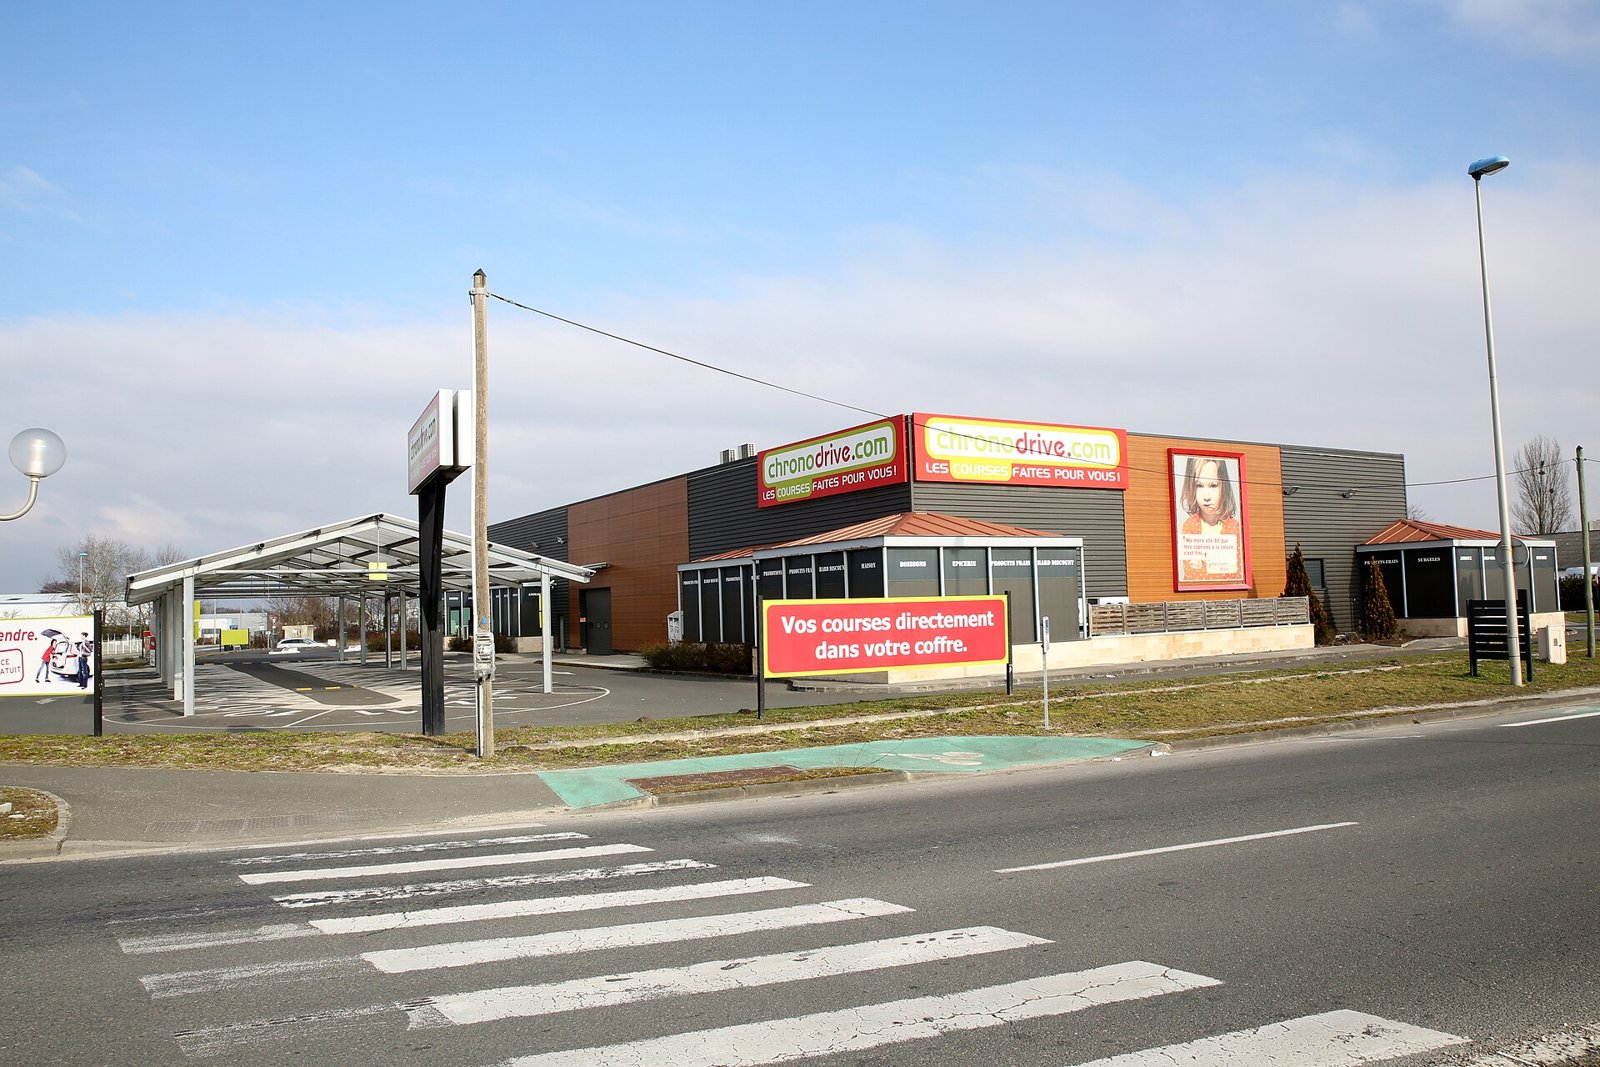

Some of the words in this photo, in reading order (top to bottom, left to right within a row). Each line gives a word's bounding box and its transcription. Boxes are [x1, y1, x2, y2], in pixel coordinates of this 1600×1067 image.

[936, 427, 1111, 460] chronodrive.com
[768, 436, 888, 479] chronodrive.com
[925, 462, 949, 474] LES
[953, 463, 1010, 477] COURSES
[1012, 467, 1051, 479] FAITES
[1054, 468, 1085, 480] POUR
[762, 490, 776, 501] LES
[776, 483, 811, 498] COURSES
[812, 477, 840, 492] FAITES
[842, 471, 865, 485] POUR
[781, 615, 817, 634] Vos
[821, 615, 891, 634] courses
[895, 610, 994, 630] directement
[815, 641, 860, 660] dans
[864, 639, 911, 657] votre
[914, 636, 968, 655] coffre.
